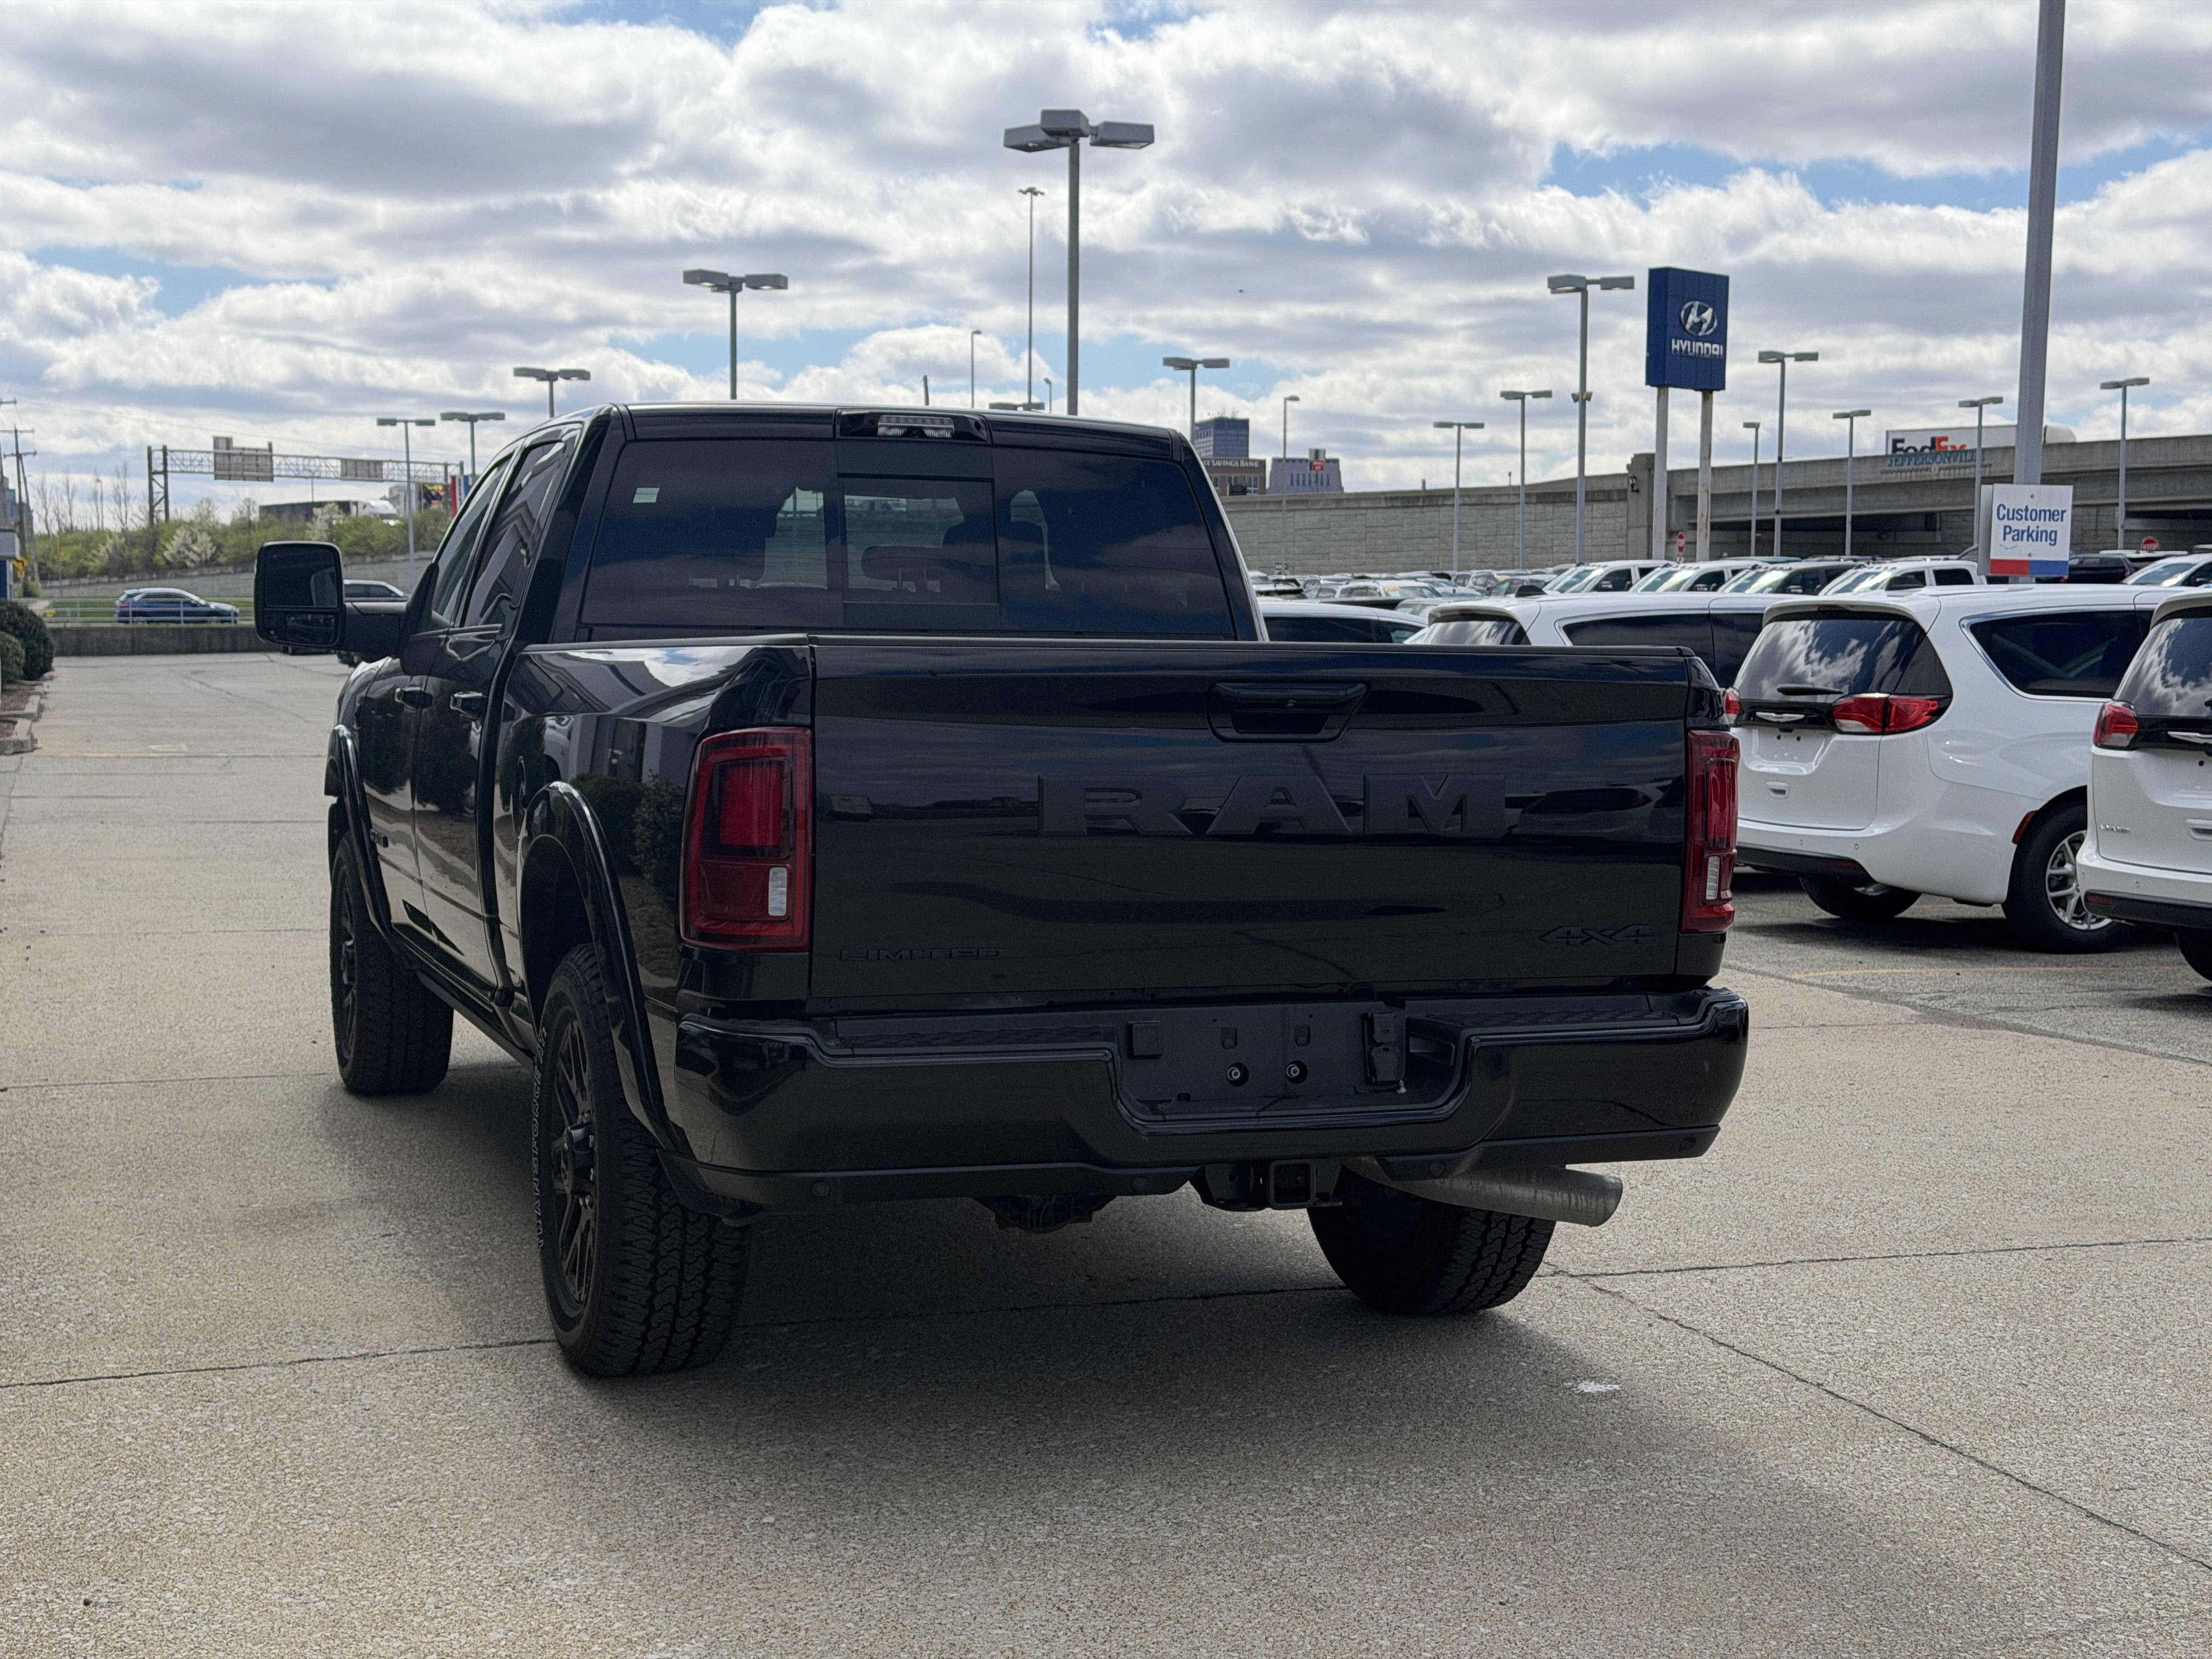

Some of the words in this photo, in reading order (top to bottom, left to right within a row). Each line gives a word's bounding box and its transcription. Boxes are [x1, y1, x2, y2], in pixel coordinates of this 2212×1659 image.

[1671, 338, 1723, 358] HYUNDAI
[1996, 503, 2067, 522] Customer
[2002, 525, 2057, 546] Parking
[1038, 774, 1506, 837] RAM
[839, 947, 1006, 961] LIMITED
